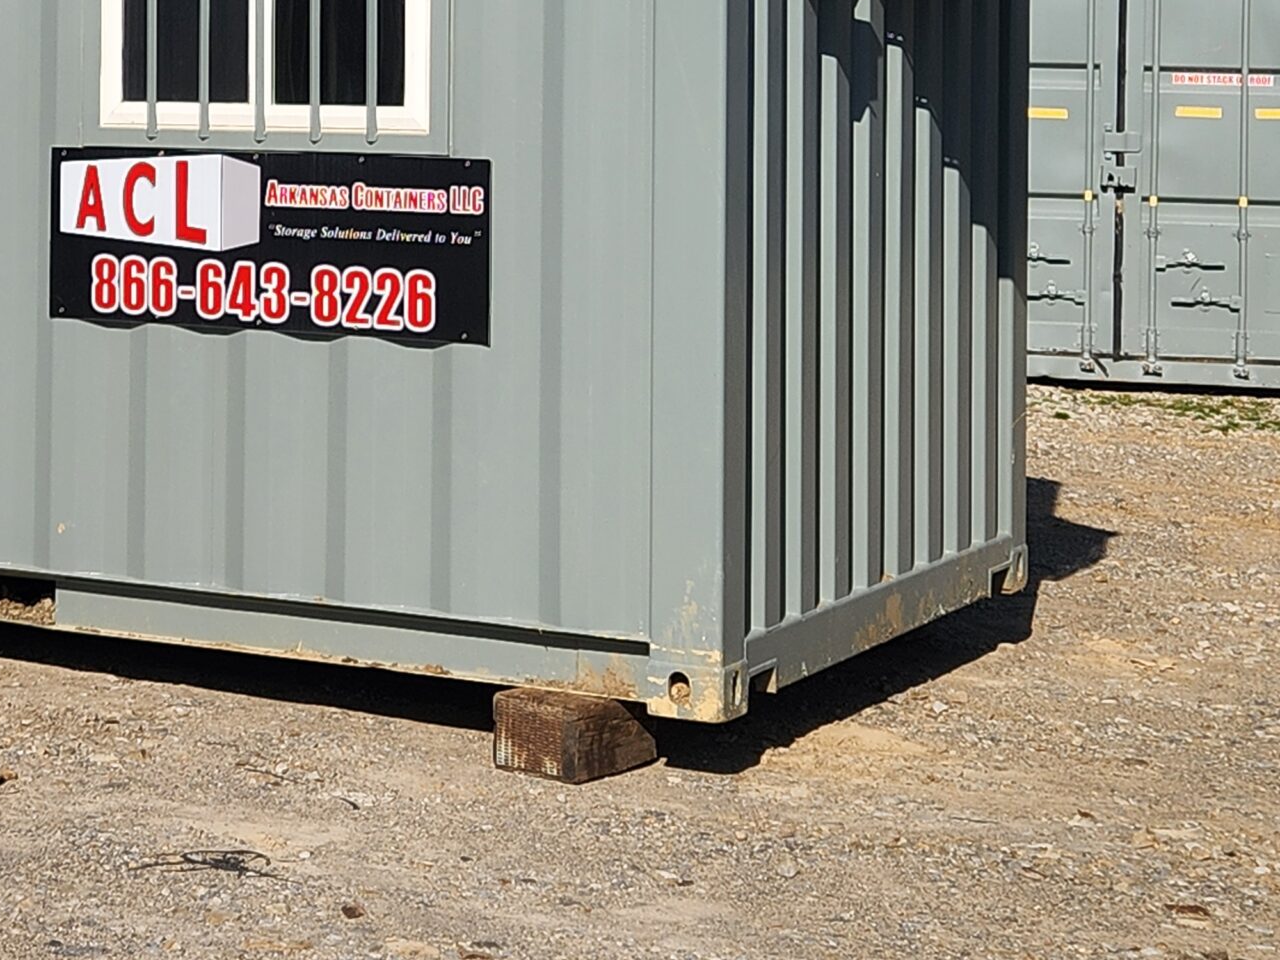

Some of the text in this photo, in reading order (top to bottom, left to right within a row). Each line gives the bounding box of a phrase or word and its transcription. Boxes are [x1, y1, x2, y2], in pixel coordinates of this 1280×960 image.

[1174, 74, 1185, 83] DO
[1188, 74, 1204, 83] NOT
[1207, 75, 1233, 84] STACK
[75, 160, 207, 244] ACL
[265, 179, 484, 214] ARKANSAS CONTAINERS LLC
[320, 226, 372, 240] Solutions
[376, 228, 431, 243] Delivered
[435, 233, 446, 243] to
[91, 253, 436, 332] 866-643-8226
